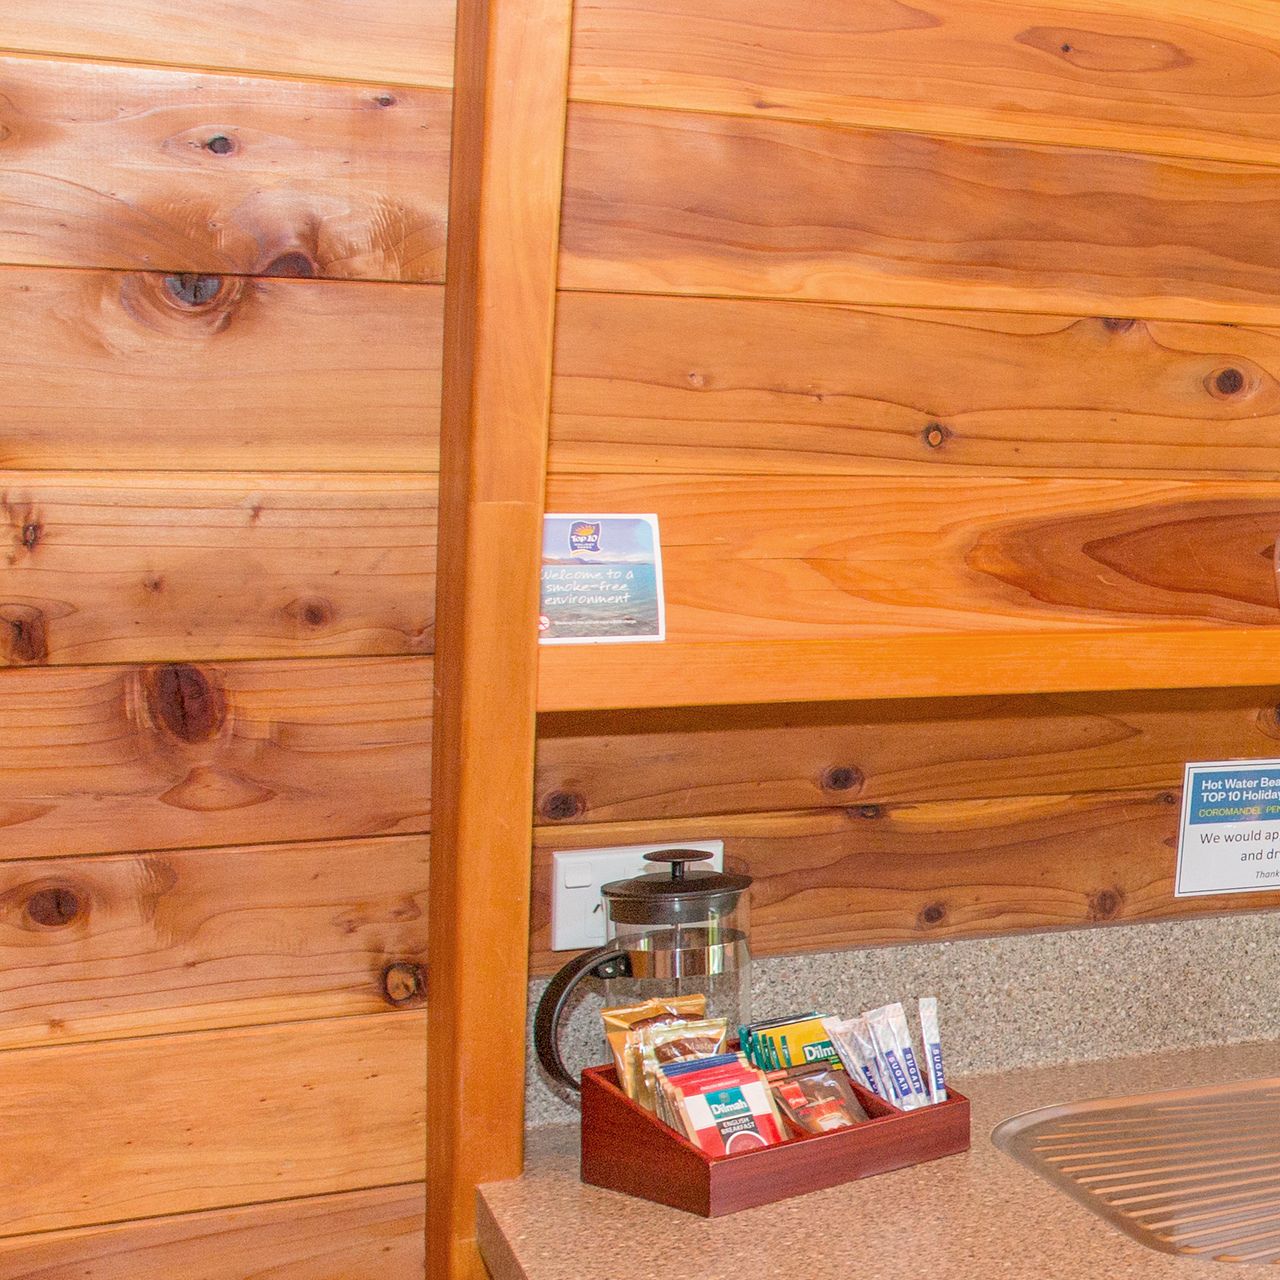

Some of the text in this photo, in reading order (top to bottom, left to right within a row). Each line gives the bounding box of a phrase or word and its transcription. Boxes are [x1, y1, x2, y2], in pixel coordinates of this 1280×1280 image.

[571, 535, 586, 543] Top
[541, 569, 634, 580] Welcome to a
[546, 581, 629, 592] smoke-free
[545, 592, 631, 605] environment
[1202, 780, 1223, 790] Hot
[1225, 779, 1259, 789] Water
[1201, 792, 1226, 802] TOP
[1228, 791, 1240, 801] 10
[1199, 806, 1262, 817] COROMANDEL
[1200, 833, 1220, 844] We
[1224, 830, 1261, 843] would
[1240, 849, 1263, 862] and
[1255, 870, 1280, 879] Thank
[804, 1046, 835, 1061] Dilm
[888, 1053, 908, 1092] SUGAR
[905, 1053, 920, 1089] SUGAR
[932, 1049, 943, 1085] SUGAR
[711, 1099, 748, 1114] Dilmah
[721, 1122, 754, 1134] BREAKFAST
[723, 1117, 749, 1127] ENGLISH
